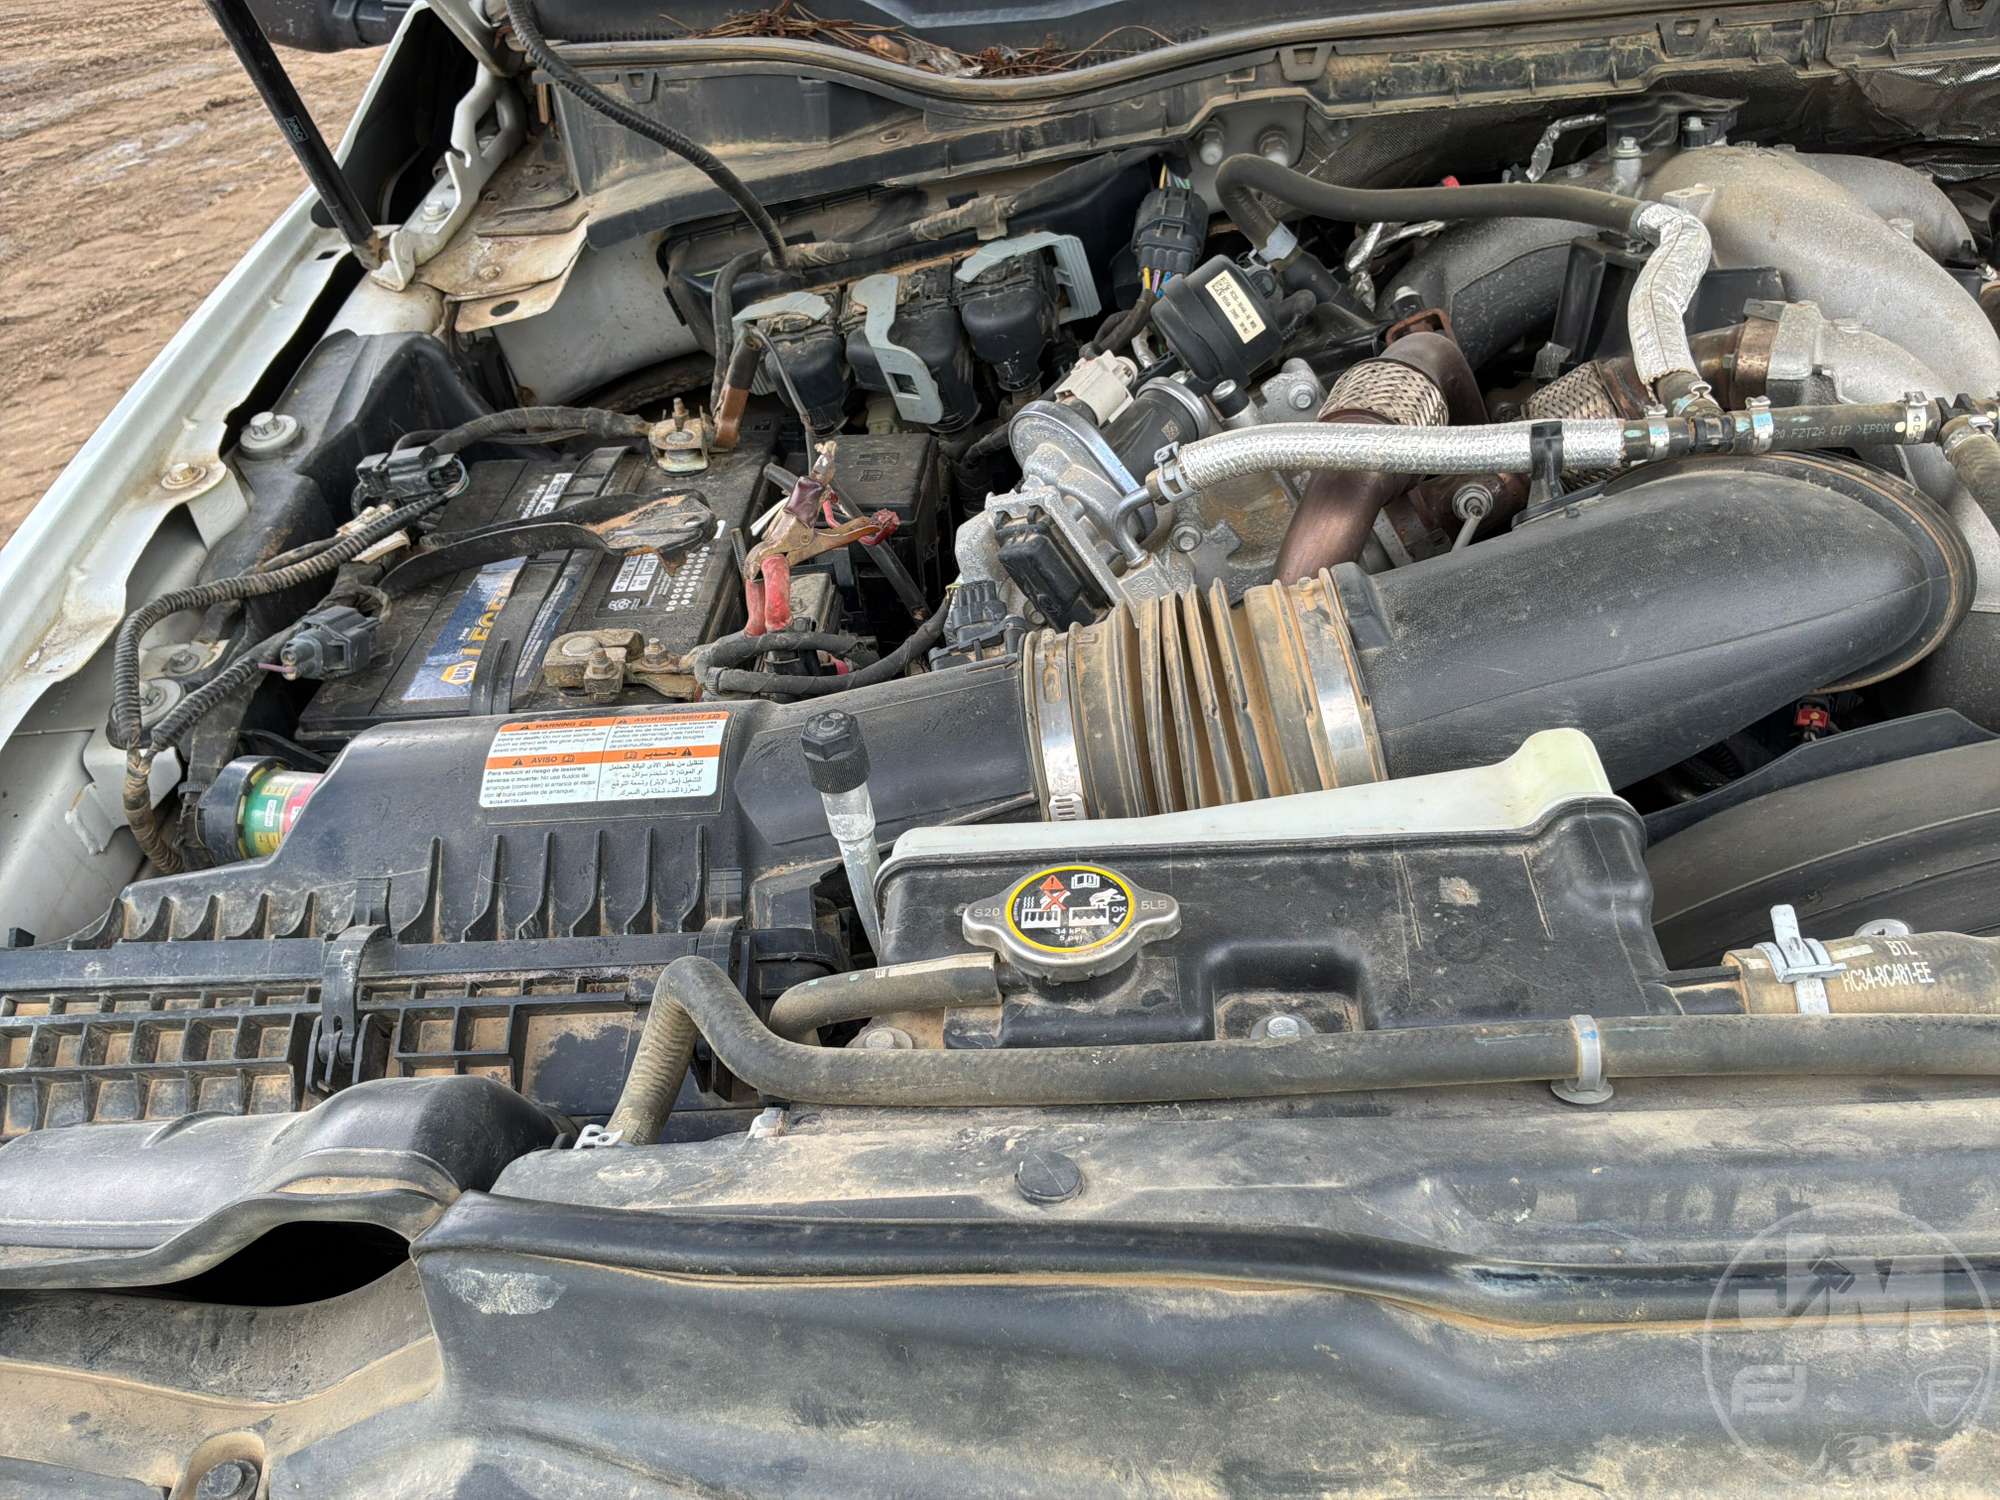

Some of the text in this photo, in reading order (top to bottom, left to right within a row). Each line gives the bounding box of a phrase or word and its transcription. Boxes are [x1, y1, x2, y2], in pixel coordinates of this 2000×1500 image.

[530, 756, 558, 764] AVISO
[1140, 900, 1168, 910] 5LB
[974, 907, 1000, 917] S20
[1884, 940, 1918, 956] BTL
